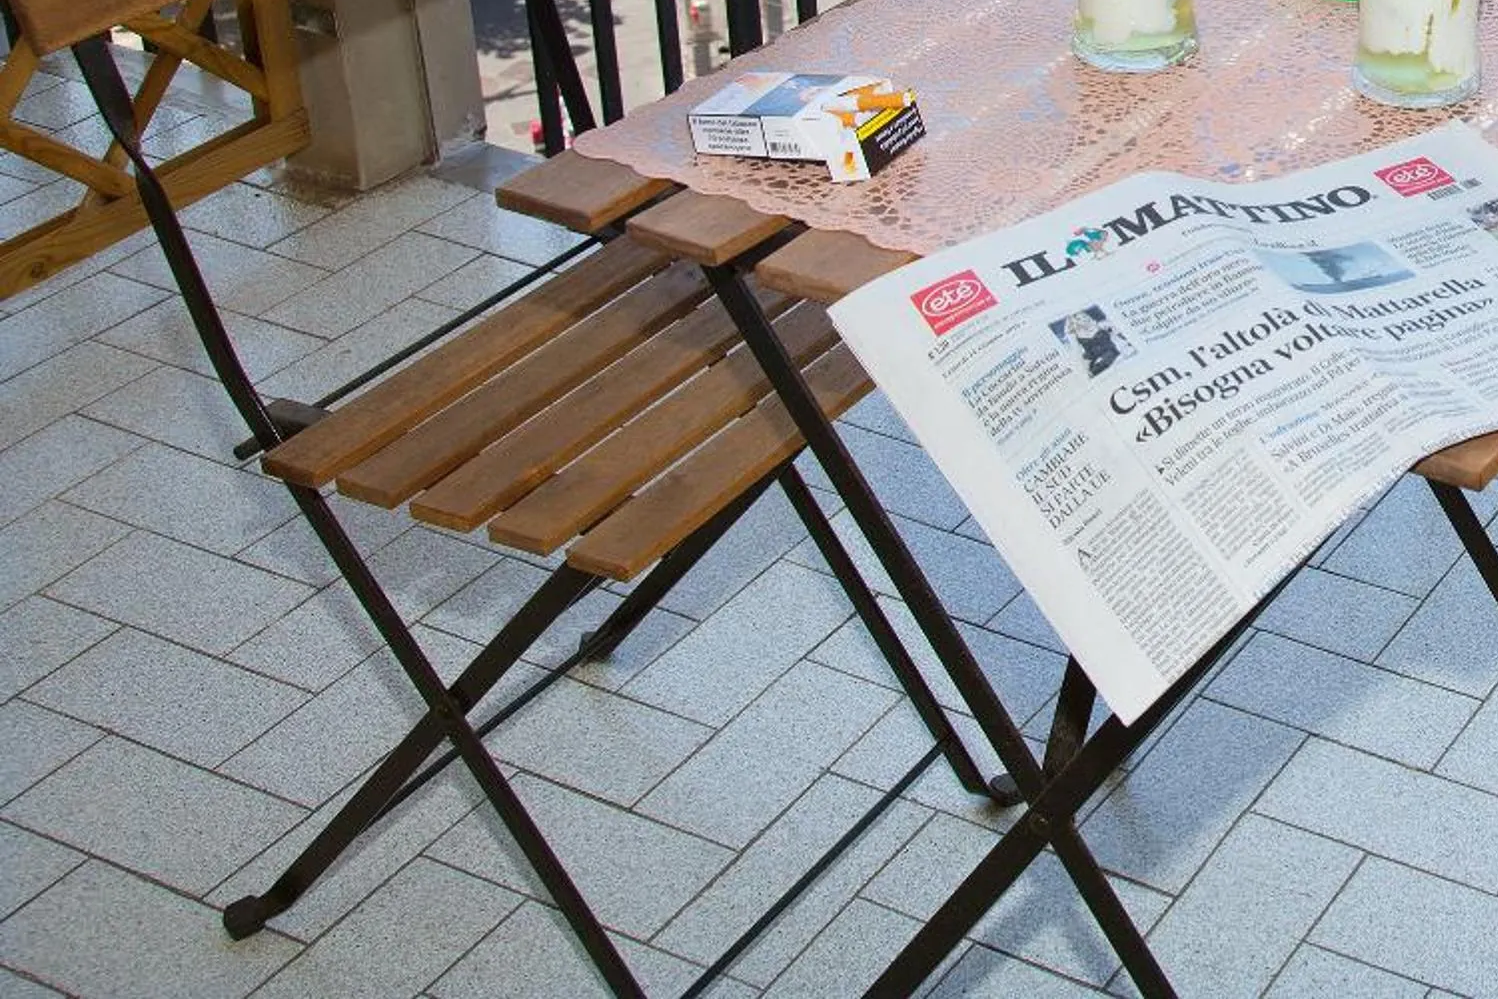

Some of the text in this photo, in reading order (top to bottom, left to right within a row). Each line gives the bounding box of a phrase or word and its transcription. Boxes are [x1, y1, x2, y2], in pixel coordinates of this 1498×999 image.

[1002, 251, 1077, 288] IL
[1103, 185, 1372, 247] MATTINO
[1109, 362, 1193, 416] Csm,
[1187, 306, 1300, 370] l'altolà
[1330, 278, 1486, 325] Mattarella
[1134, 358, 1274, 444] «Bisogna
[1383, 297, 1494, 342] pagina»
[1023, 433, 1090, 494] CAMBIARE
